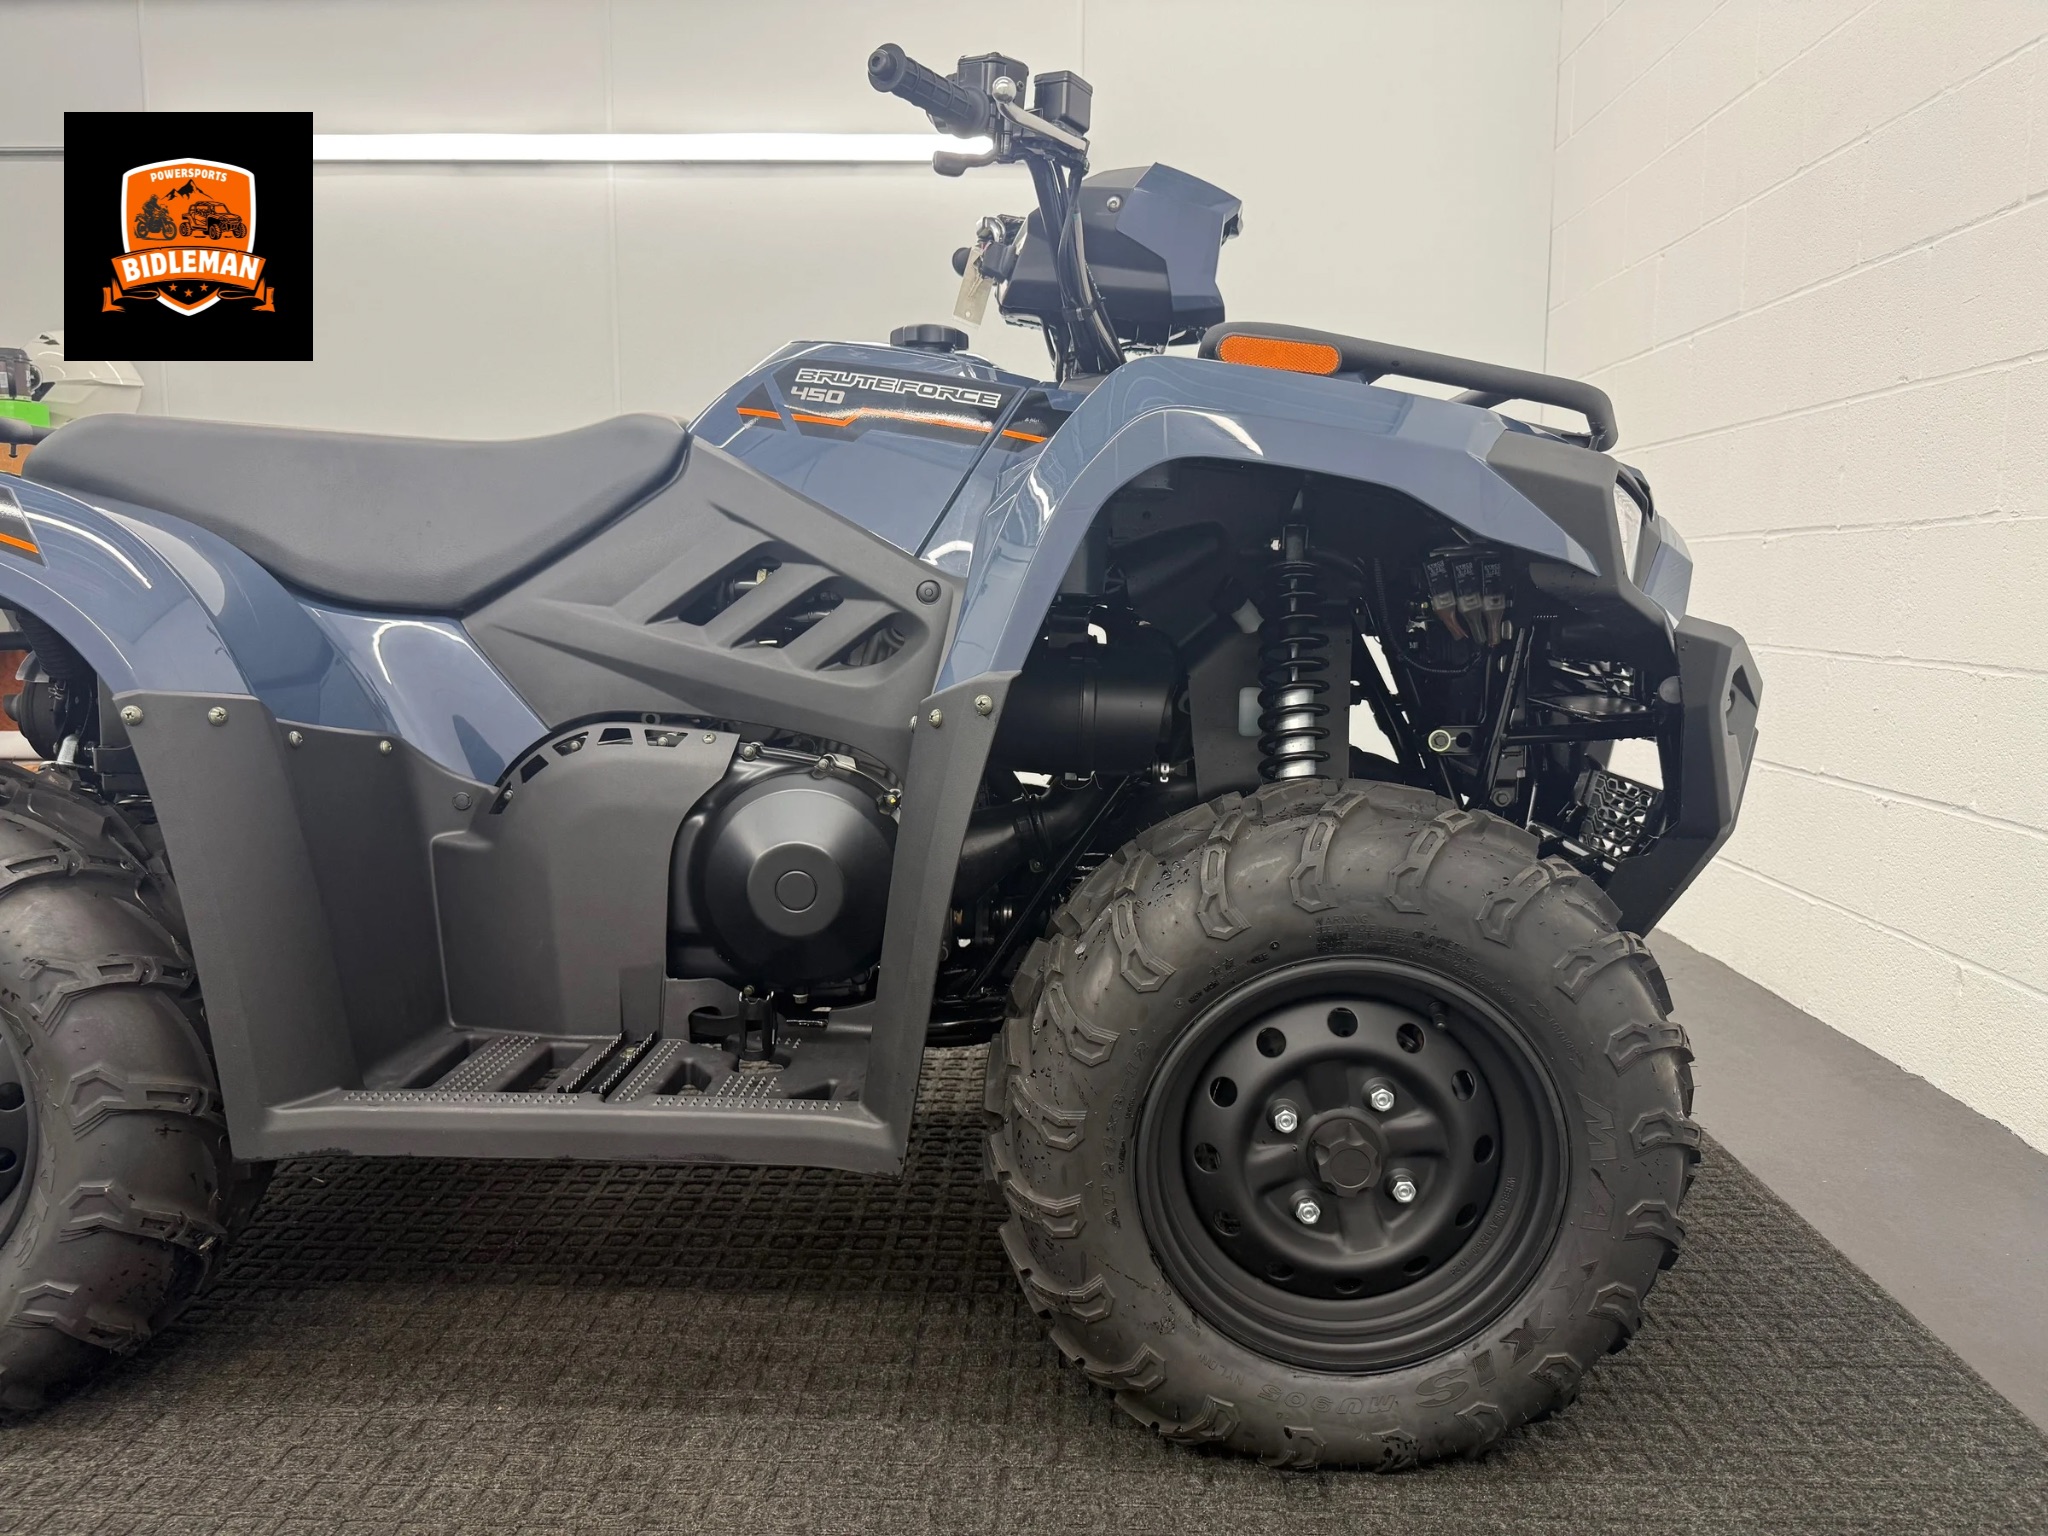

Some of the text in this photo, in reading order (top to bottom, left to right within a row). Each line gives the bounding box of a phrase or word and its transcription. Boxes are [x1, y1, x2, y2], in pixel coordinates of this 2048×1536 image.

[790, 385, 846, 405] 450
[795, 368, 1002, 408] BRUTE FORCE
